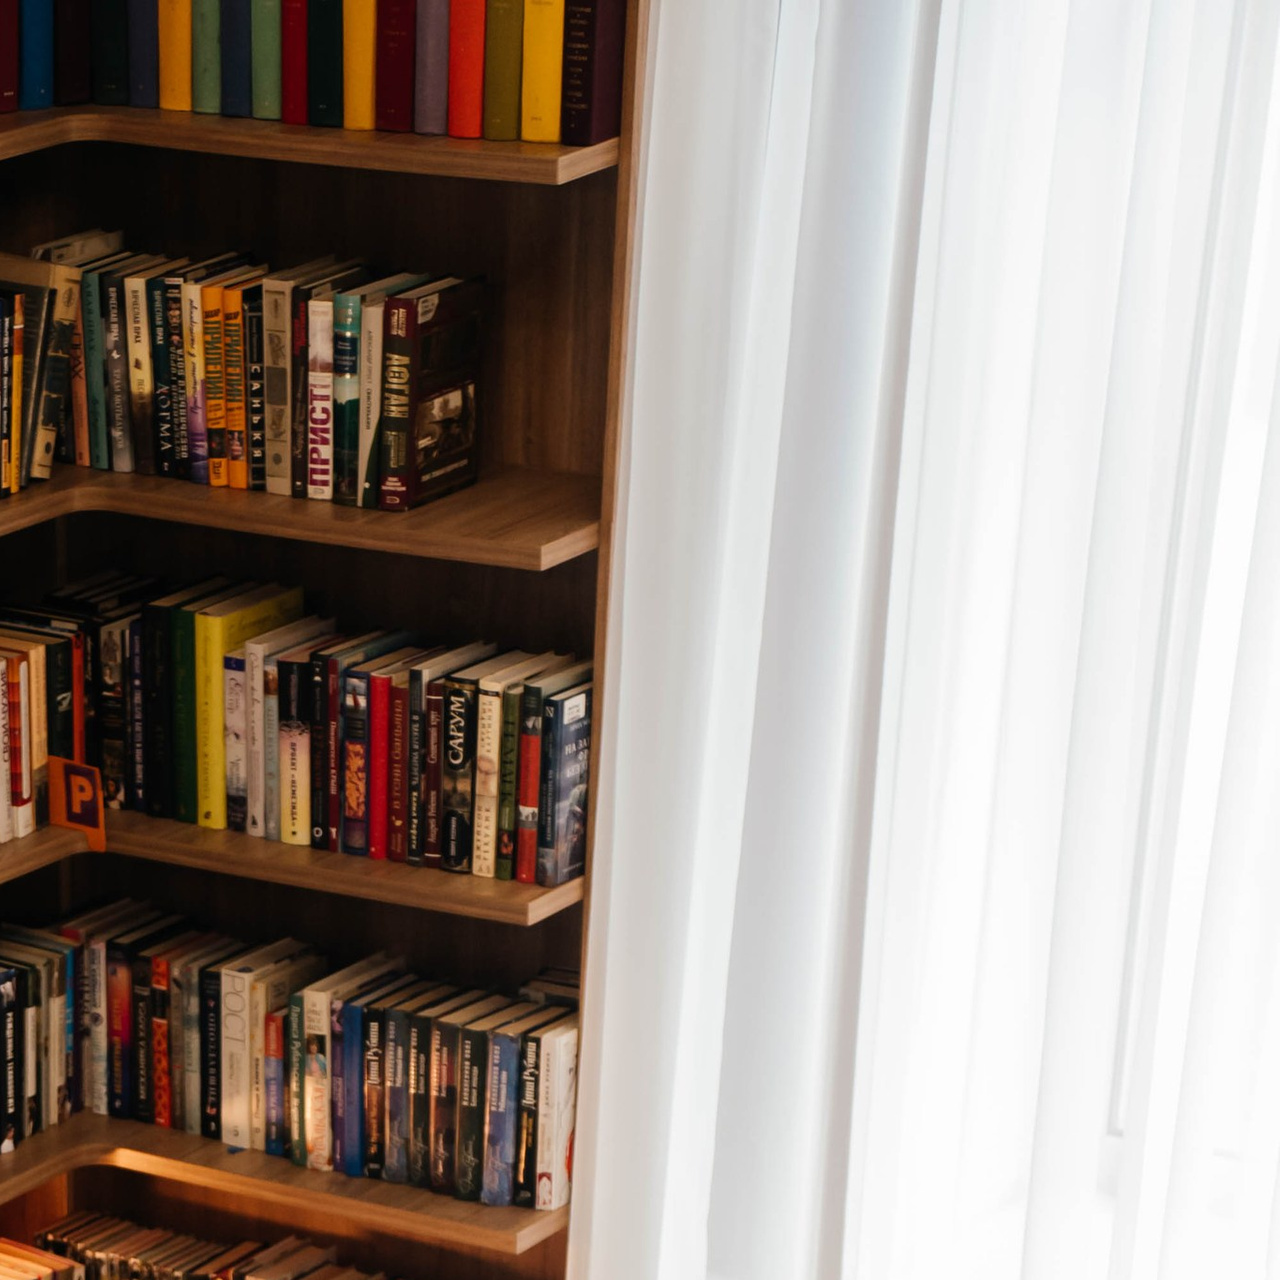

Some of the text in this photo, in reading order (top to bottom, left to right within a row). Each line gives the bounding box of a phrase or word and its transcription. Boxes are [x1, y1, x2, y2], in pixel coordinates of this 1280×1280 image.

[132, 325, 142, 343] ПРАХ
[250, 366, 262, 458] САНЬКЯ
[448, 695, 465, 764] САРУМ
[71, 774, 94, 814] Р
[223, 972, 245, 1046] РОСТ
